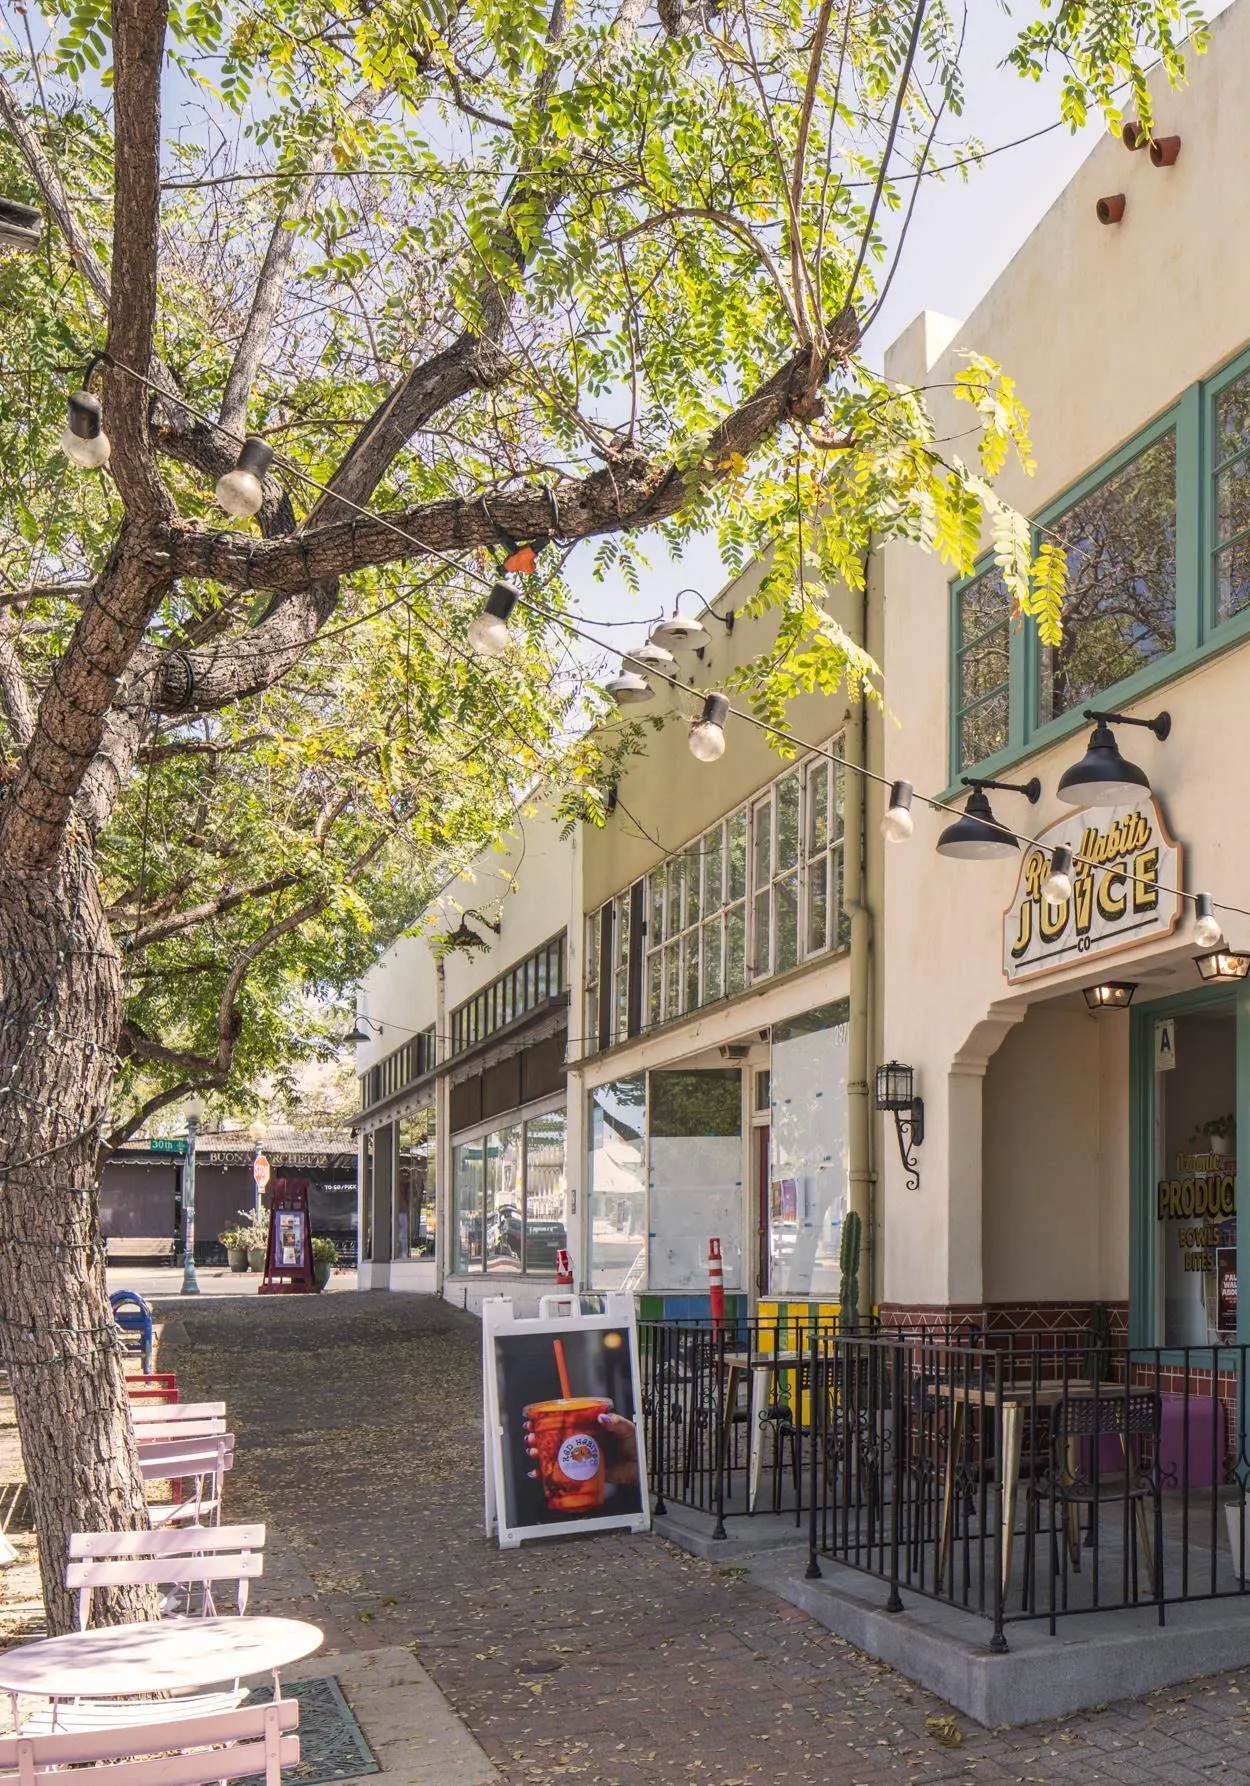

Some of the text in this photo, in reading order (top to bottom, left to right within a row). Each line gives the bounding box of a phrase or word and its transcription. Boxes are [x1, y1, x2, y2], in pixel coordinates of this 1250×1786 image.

[1072, 811, 1152, 880] Habits
[1011, 847, 1159, 958] JUICE
[1077, 936, 1091, 953] CO
[1160, 1028, 1171, 1052] A
[151, 1140, 173, 1149] 30th
[209, 1152, 329, 1167] BUONA RCHETTA
[1158, 1176, 1237, 1220] PRODUC
[1179, 1227, 1220, 1248] BOWLS
[1184, 1251, 1214, 1271] BITES
